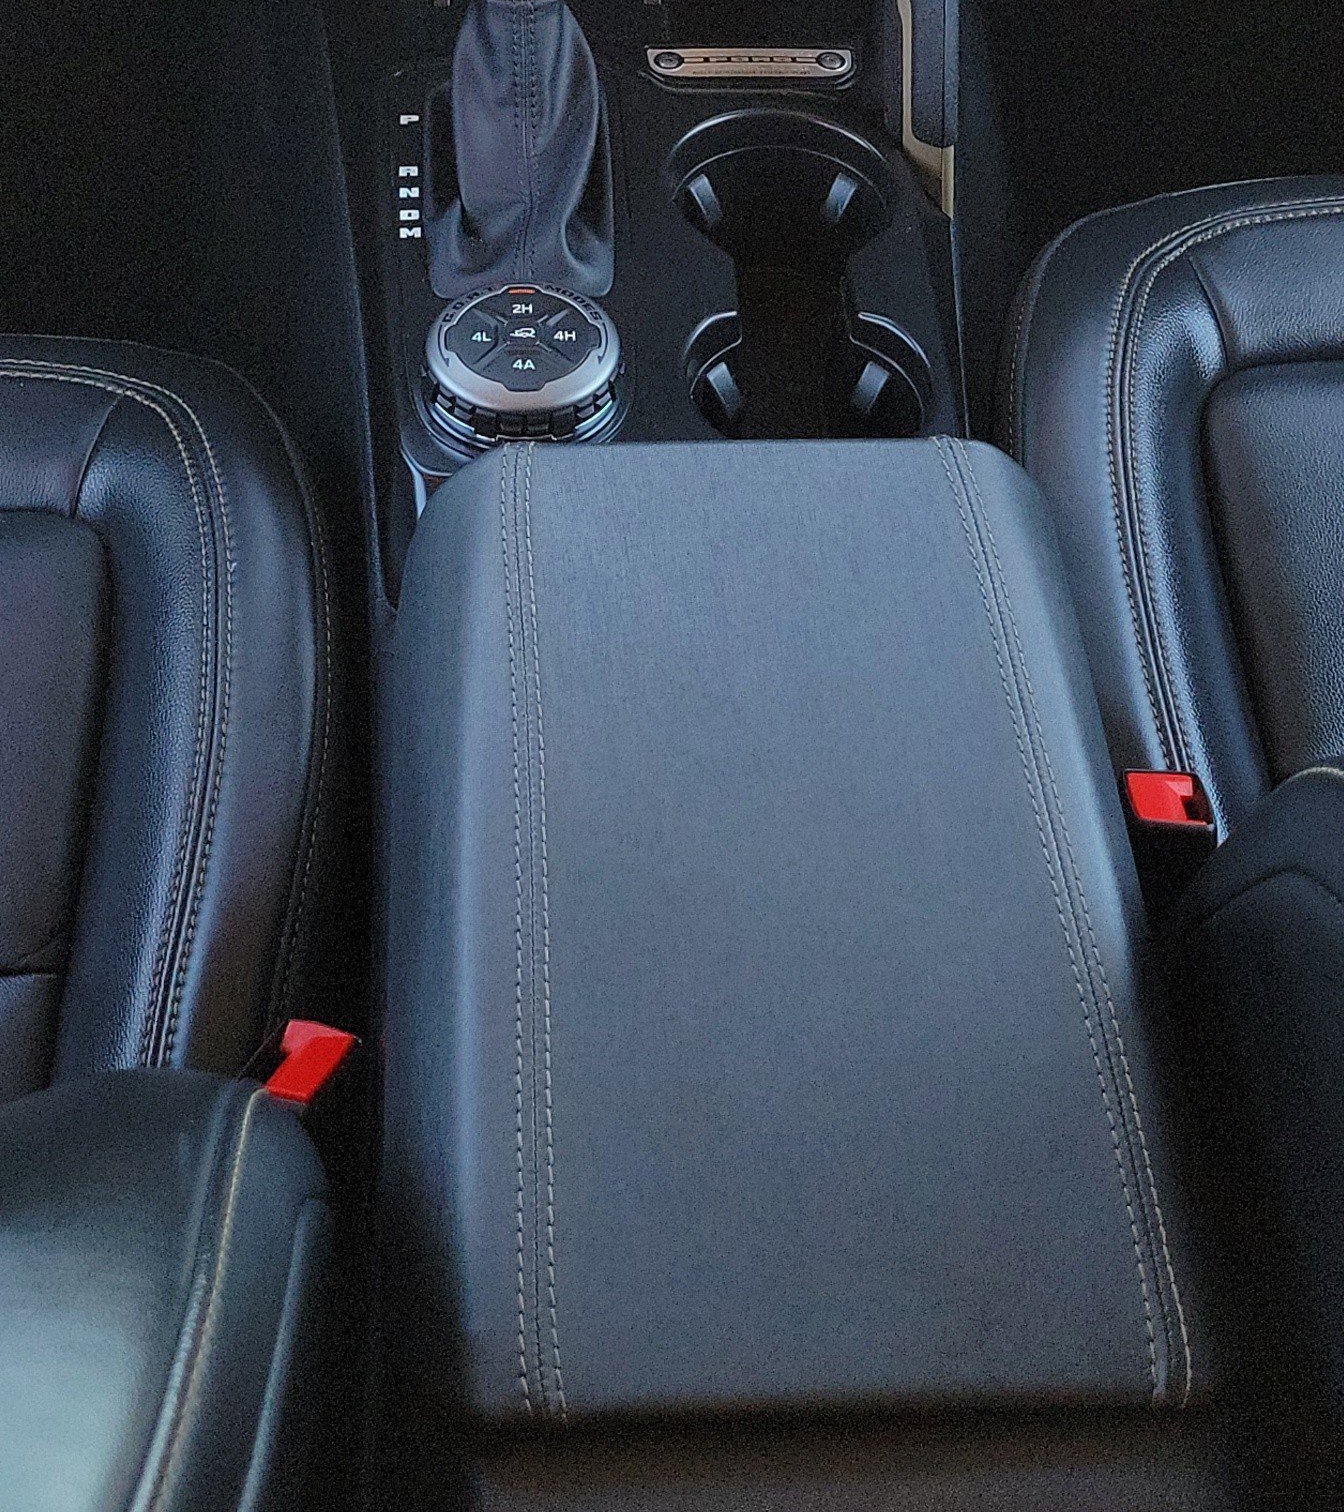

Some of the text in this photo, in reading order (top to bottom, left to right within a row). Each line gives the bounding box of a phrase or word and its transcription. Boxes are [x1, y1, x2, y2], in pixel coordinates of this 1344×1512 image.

[399, 114, 420, 125] P
[399, 187, 420, 199] N
[399, 226, 422, 239] M
[512, 303, 533, 315] 2H
[471, 331, 492, 343] 4L
[553, 330, 576, 343] 4H
[512, 358, 536, 371] 4A
